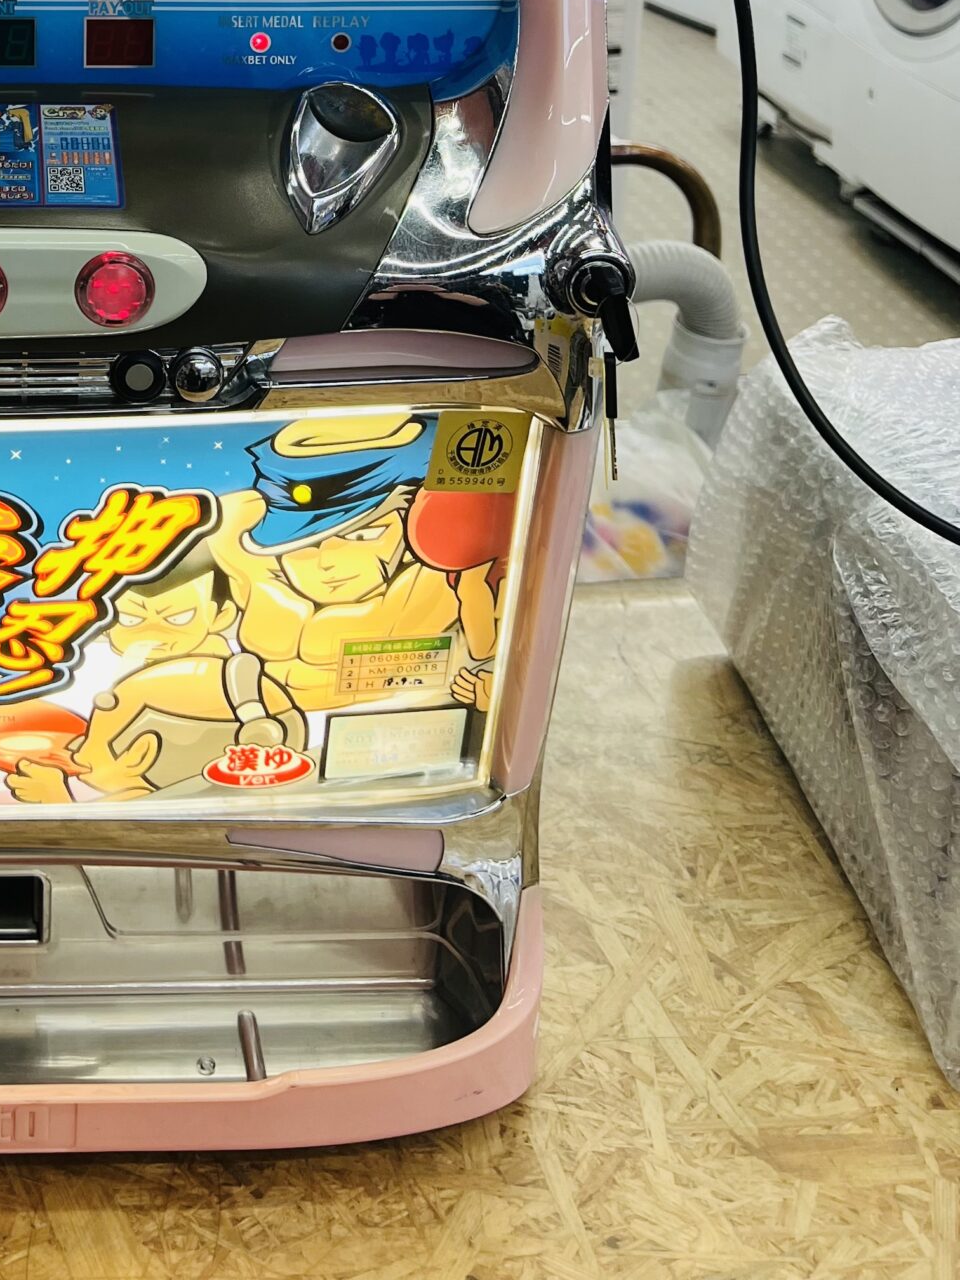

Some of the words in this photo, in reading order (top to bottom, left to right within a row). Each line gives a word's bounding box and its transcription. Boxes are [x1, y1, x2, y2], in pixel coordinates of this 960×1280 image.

[262, 15, 304, 28] MEDAL
[312, 15, 370, 28] REPLAY
[269, 55, 298, 66] ONLY
